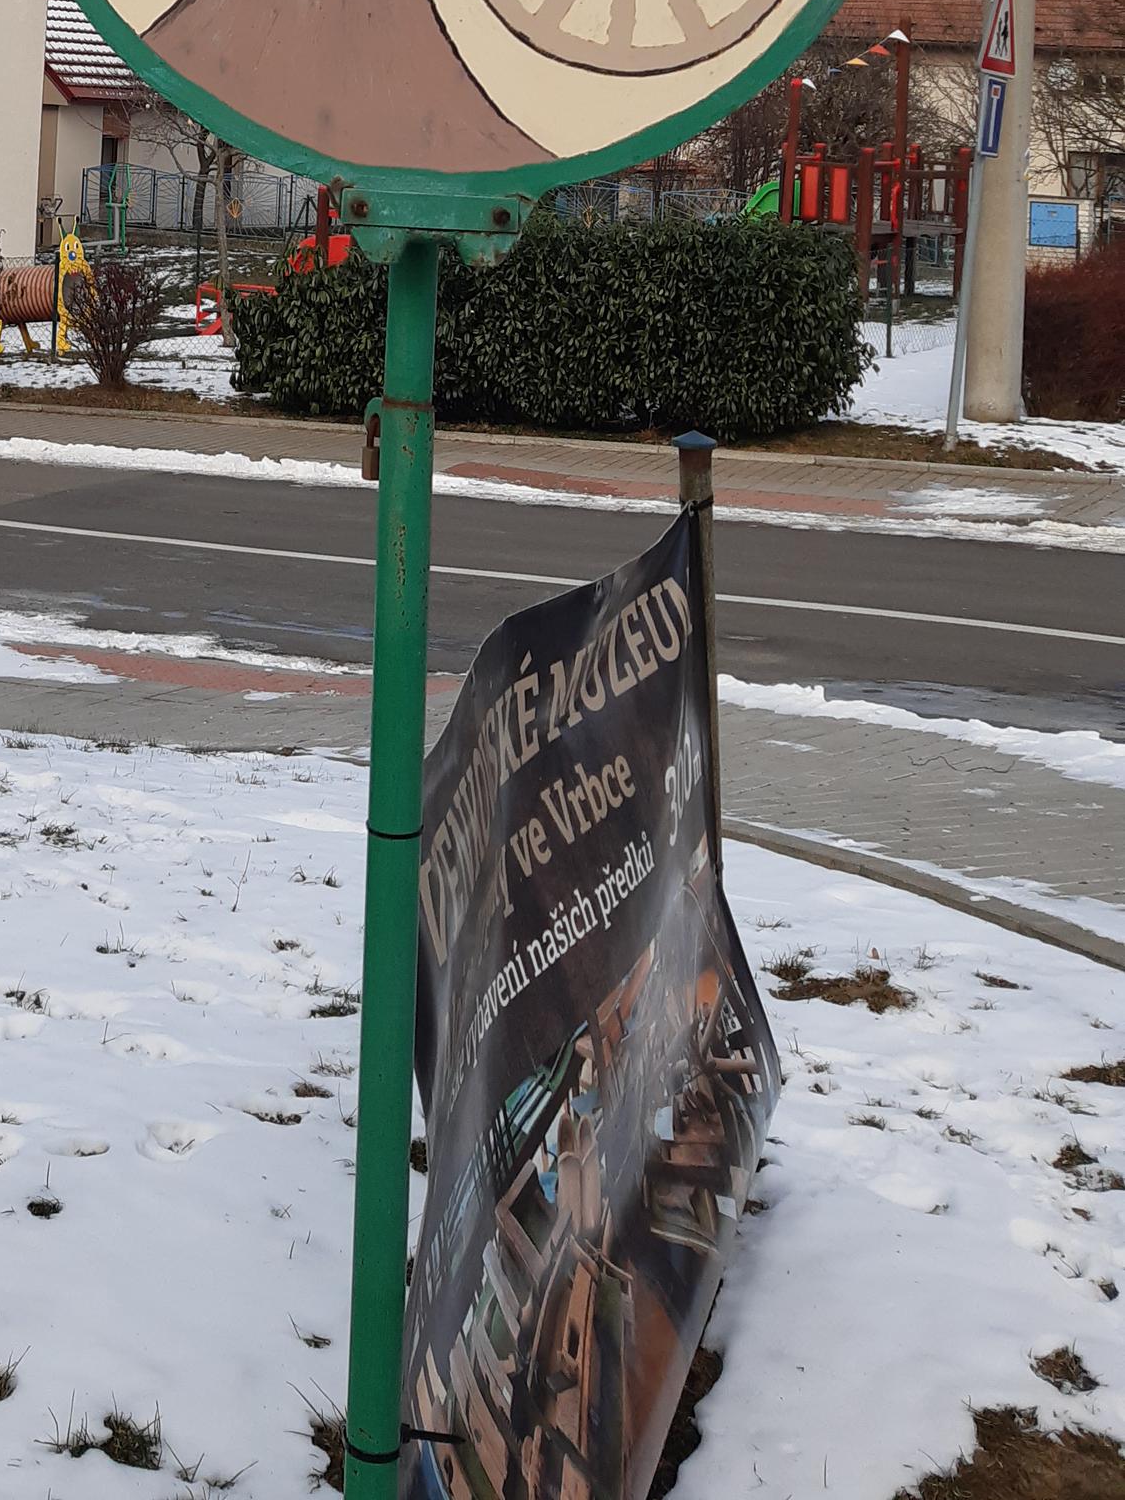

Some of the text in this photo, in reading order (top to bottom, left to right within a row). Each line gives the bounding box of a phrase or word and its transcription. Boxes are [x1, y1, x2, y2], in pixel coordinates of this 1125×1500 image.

[510, 755, 636, 878] ve Vrbce
[664, 732, 693, 847] 300
[464, 939, 531, 1069] vybavení
[527, 888, 599, 978] našich
[595, 830, 656, 931] předků
